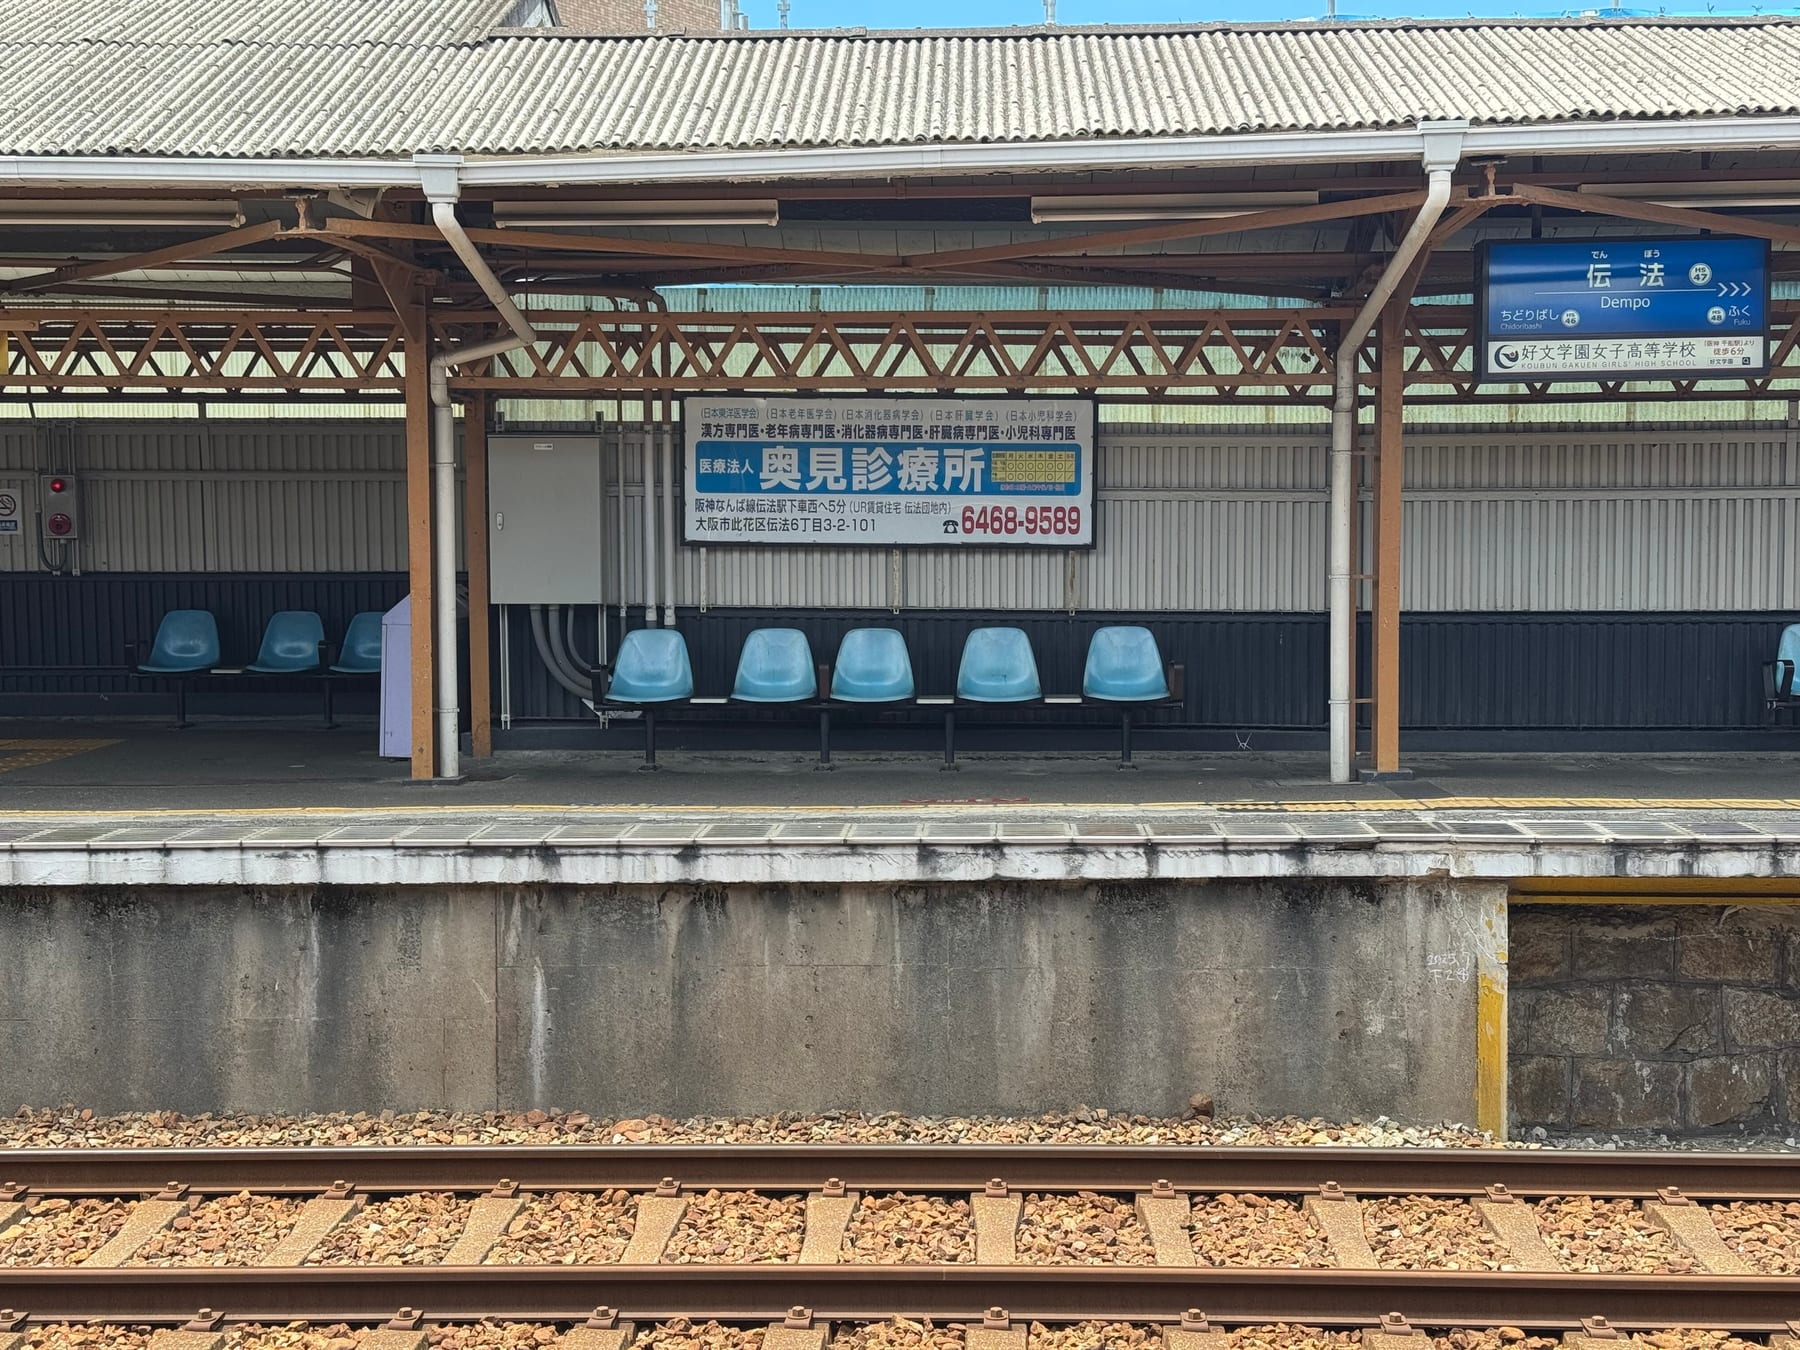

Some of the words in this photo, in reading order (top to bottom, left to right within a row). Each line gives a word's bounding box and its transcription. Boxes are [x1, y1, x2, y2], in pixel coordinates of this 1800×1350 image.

[1591, 250, 1608, 259] でん
[1644, 249, 1660, 259] ぼう
[1587, 262, 1665, 288] 伝法
[1693, 273, 1708, 282] 47
[1601, 296, 1651, 310] Dempo
[1500, 309, 1559, 322] ちどりばし
[1728, 304, 1751, 316] ふく
[1734, 318, 1751, 326] Fuku
[1521, 342, 1696, 361] 好文学園女子高等学校
[1713, 347, 1745, 356] 徒歩6分
[1661, 359, 1697, 367] SCHOOL
[699, 458, 754, 474] 医療法人
[760, 446, 987, 493] 奥見診療所
[695, 497, 847, 514] 阪神なんば線伝法駅下車西へ5分
[695, 517, 877, 533] 大阪市此花区伝法6丁目3-2-101
[961, 505, 1081, 535] 6468-9589
